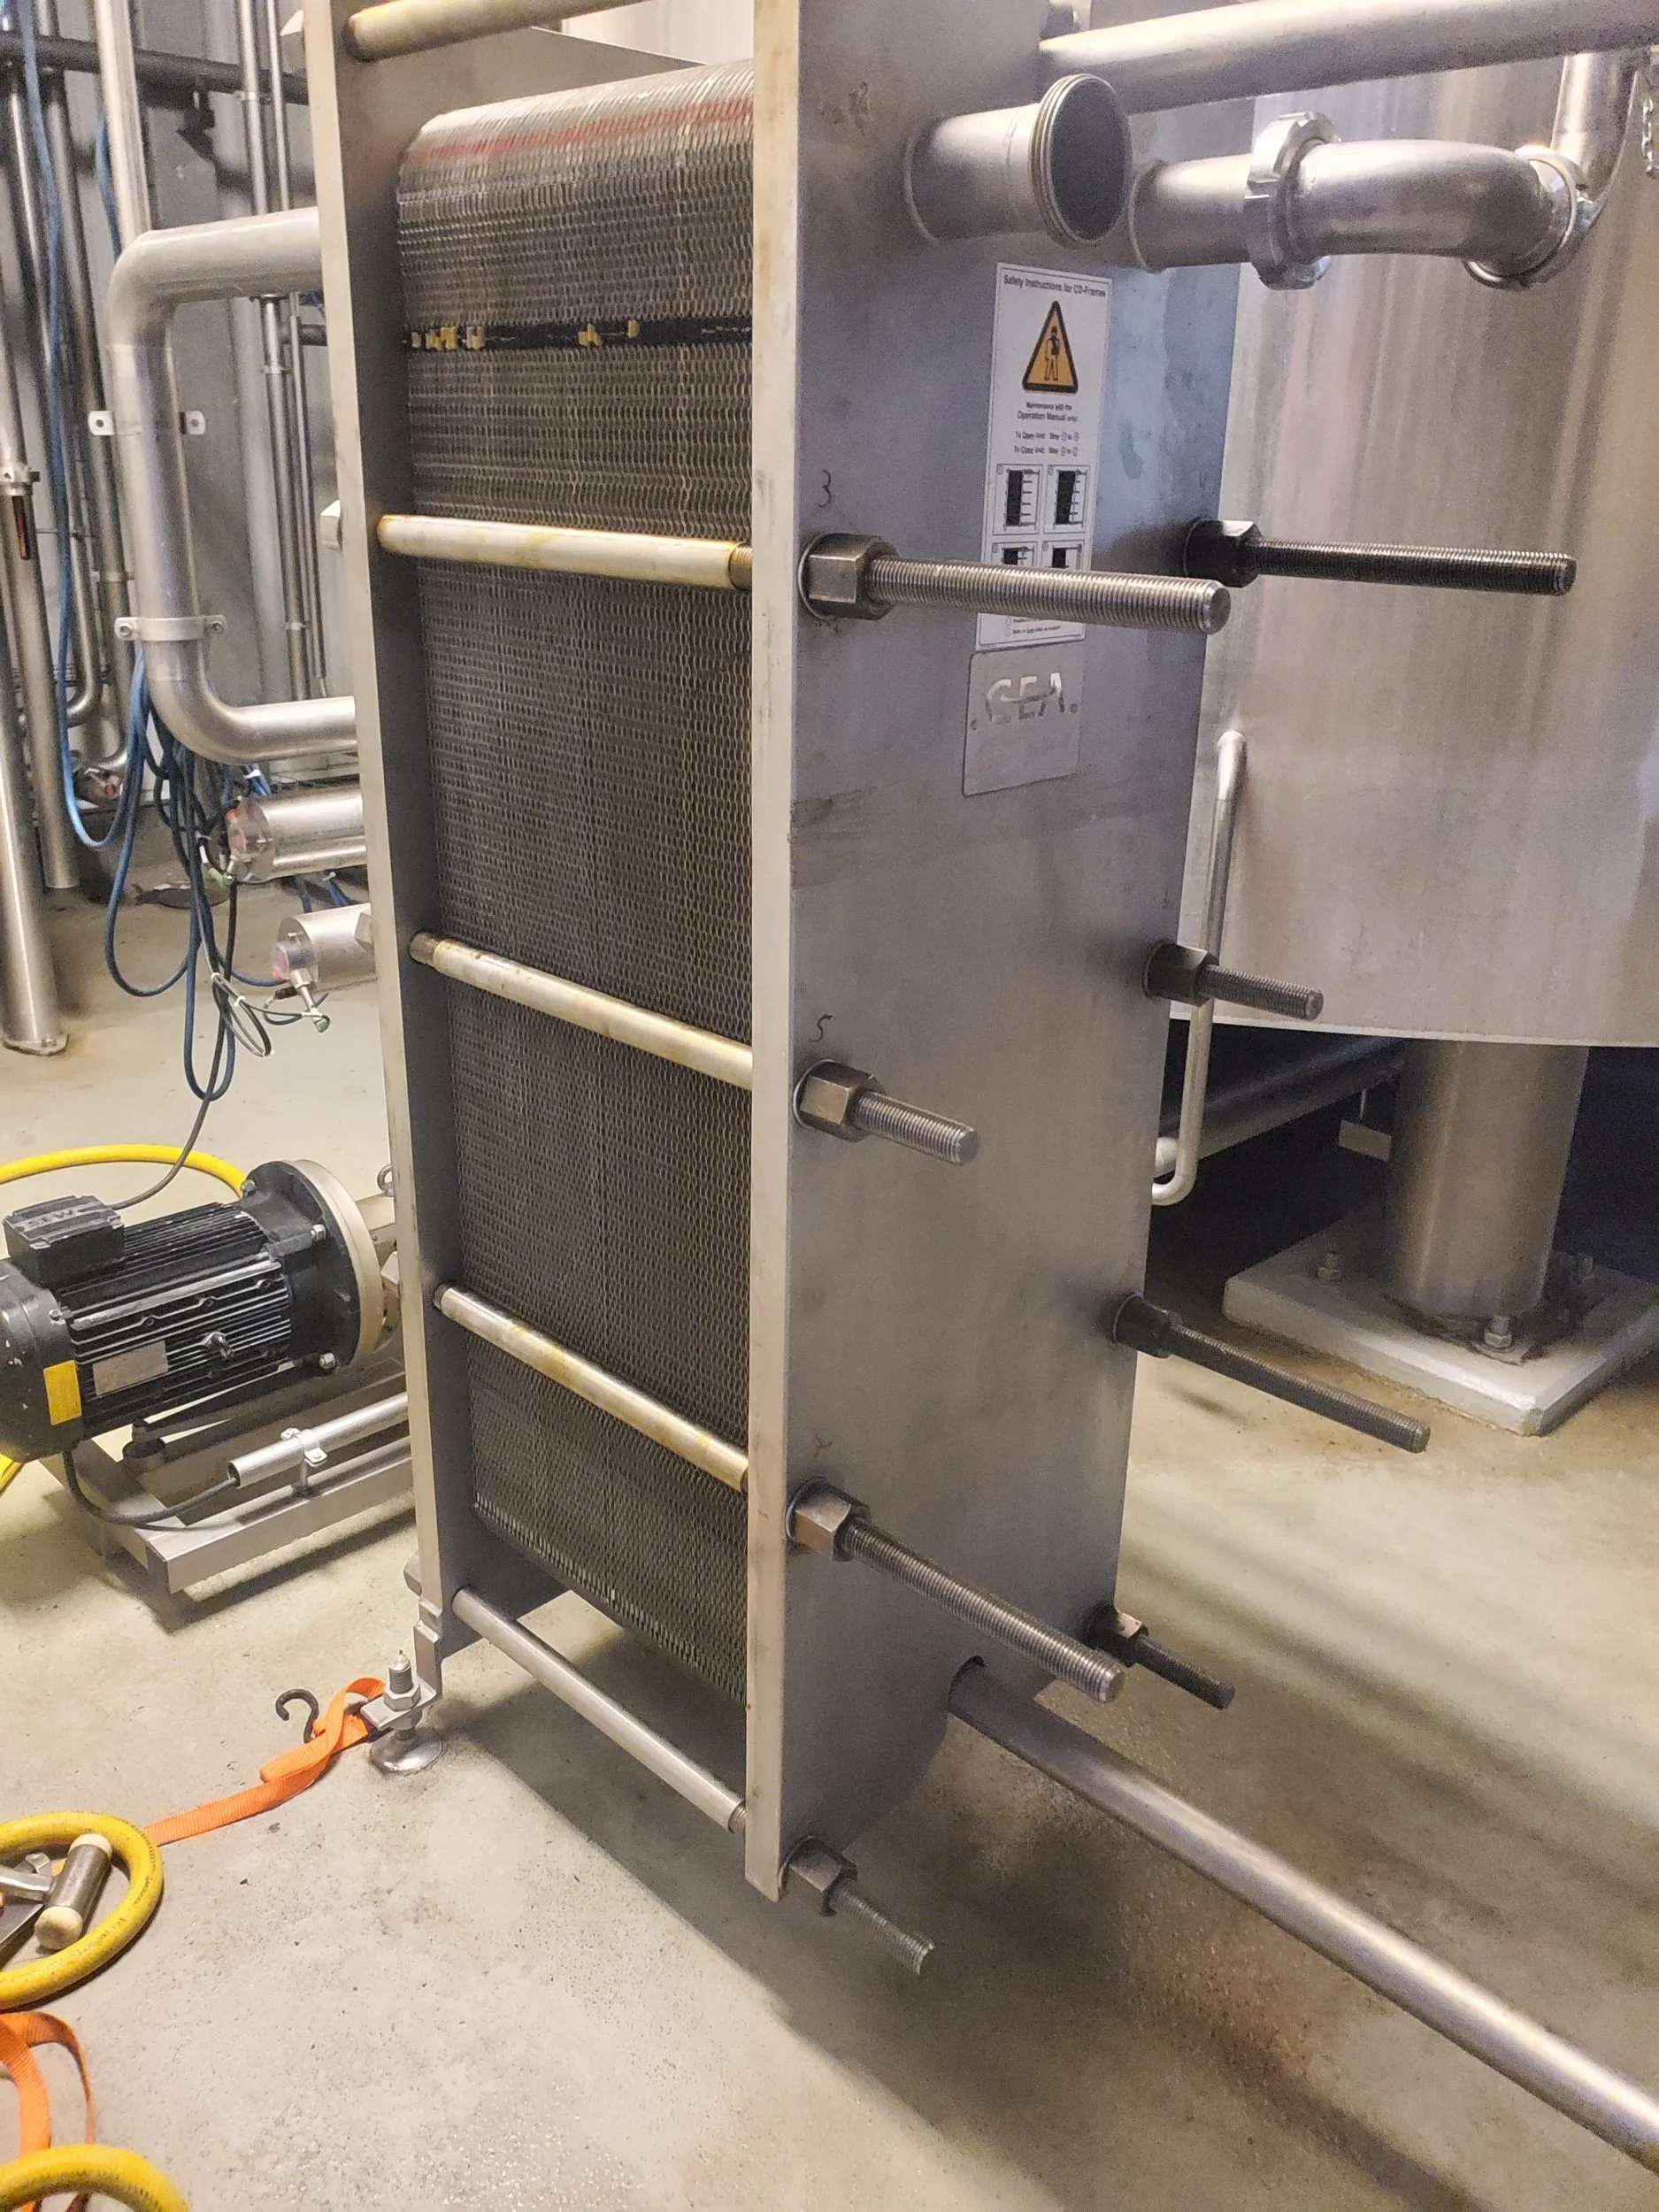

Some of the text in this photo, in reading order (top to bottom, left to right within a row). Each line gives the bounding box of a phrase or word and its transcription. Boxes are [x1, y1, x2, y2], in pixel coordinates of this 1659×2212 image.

[1003, 274, 1024, 288] Safety
[1064, 283, 1072, 294] for
[818, 468, 833, 509] 3
